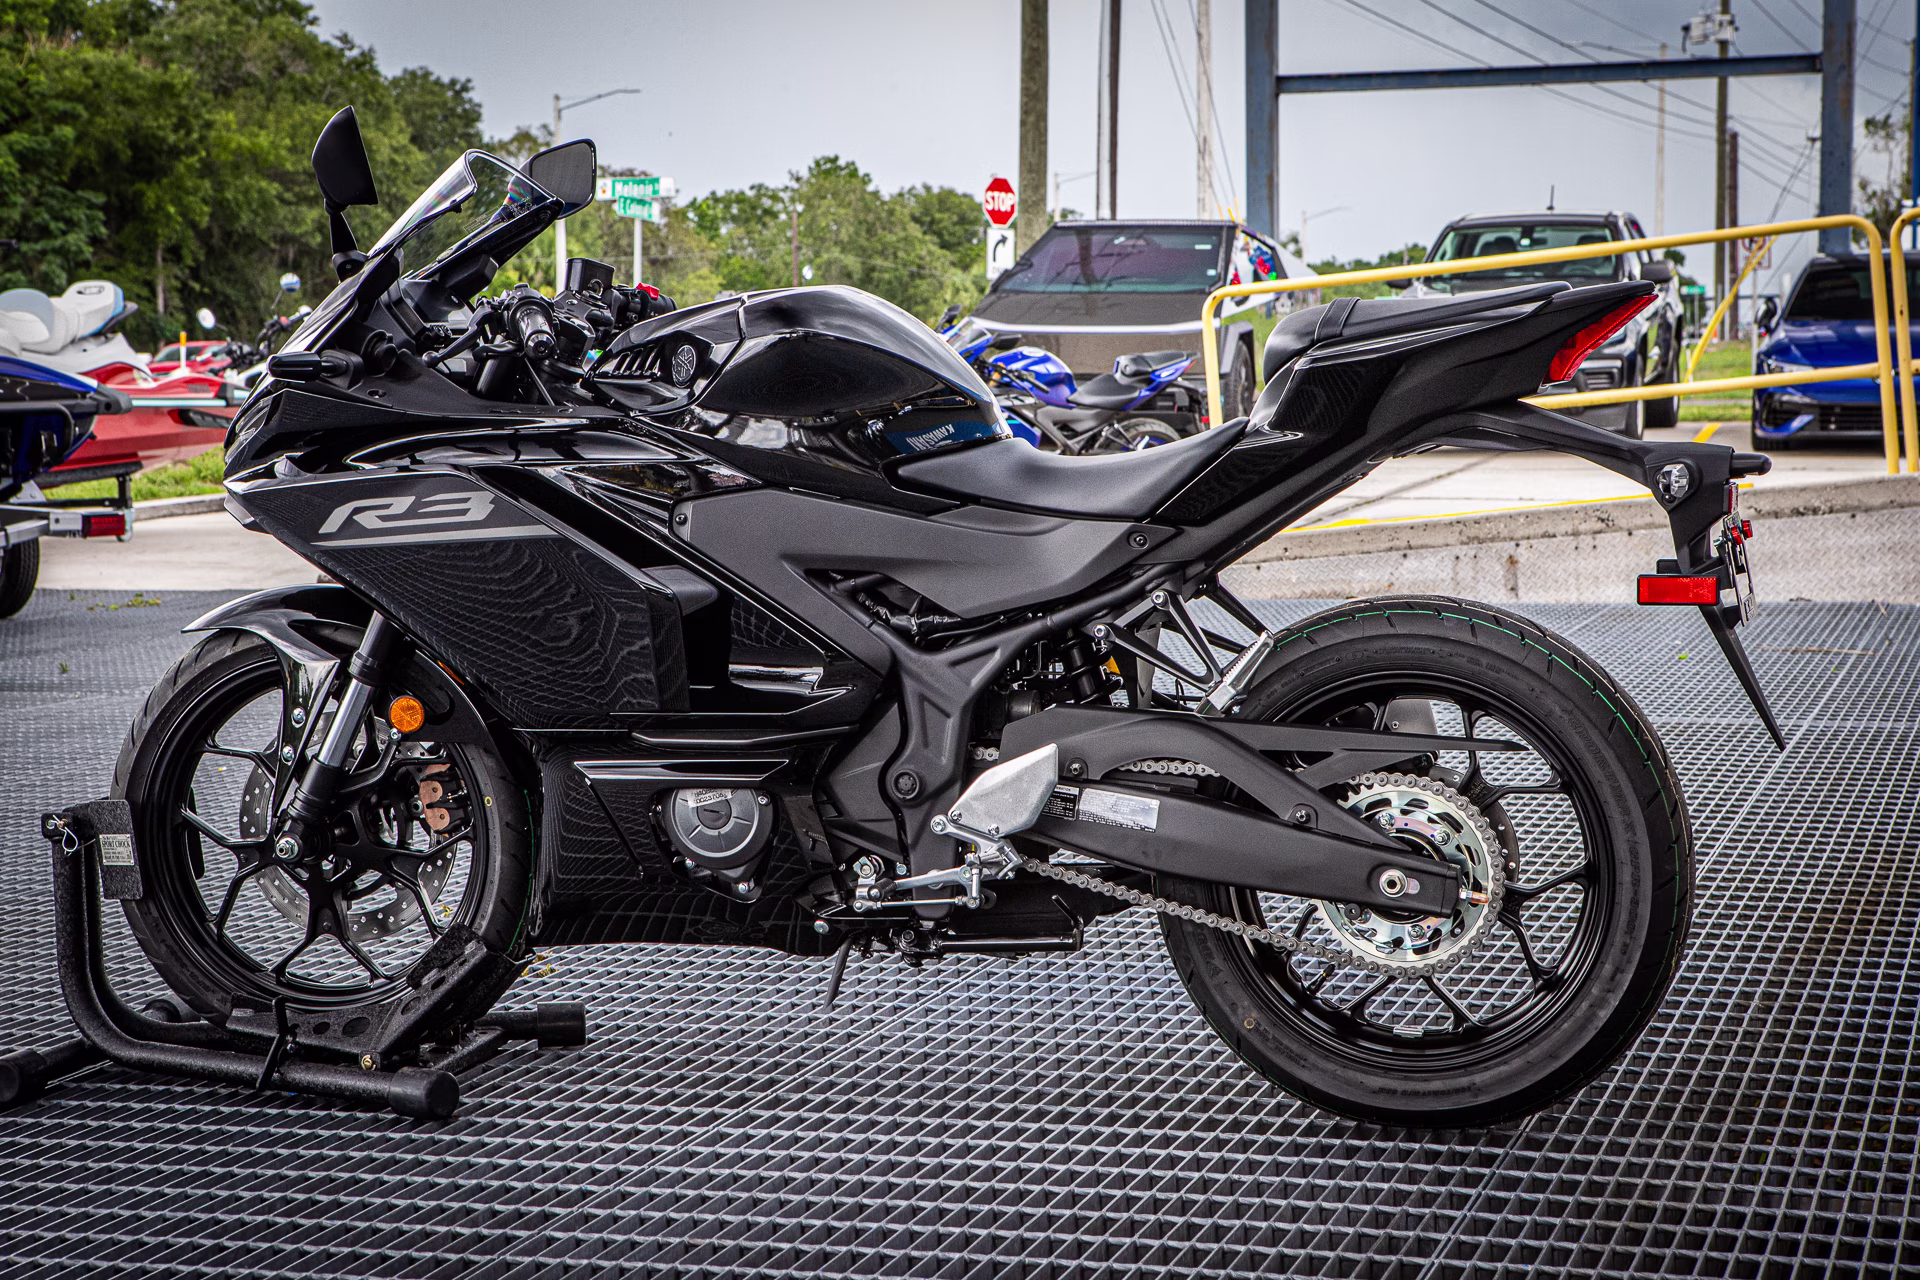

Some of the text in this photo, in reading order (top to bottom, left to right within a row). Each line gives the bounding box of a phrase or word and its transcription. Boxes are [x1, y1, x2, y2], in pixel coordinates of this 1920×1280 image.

[615, 181, 653, 197] Melanie
[986, 191, 1015, 212] STOP
[906, 424, 955, 451] KAWASAKI
[318, 490, 495, 534] R3
